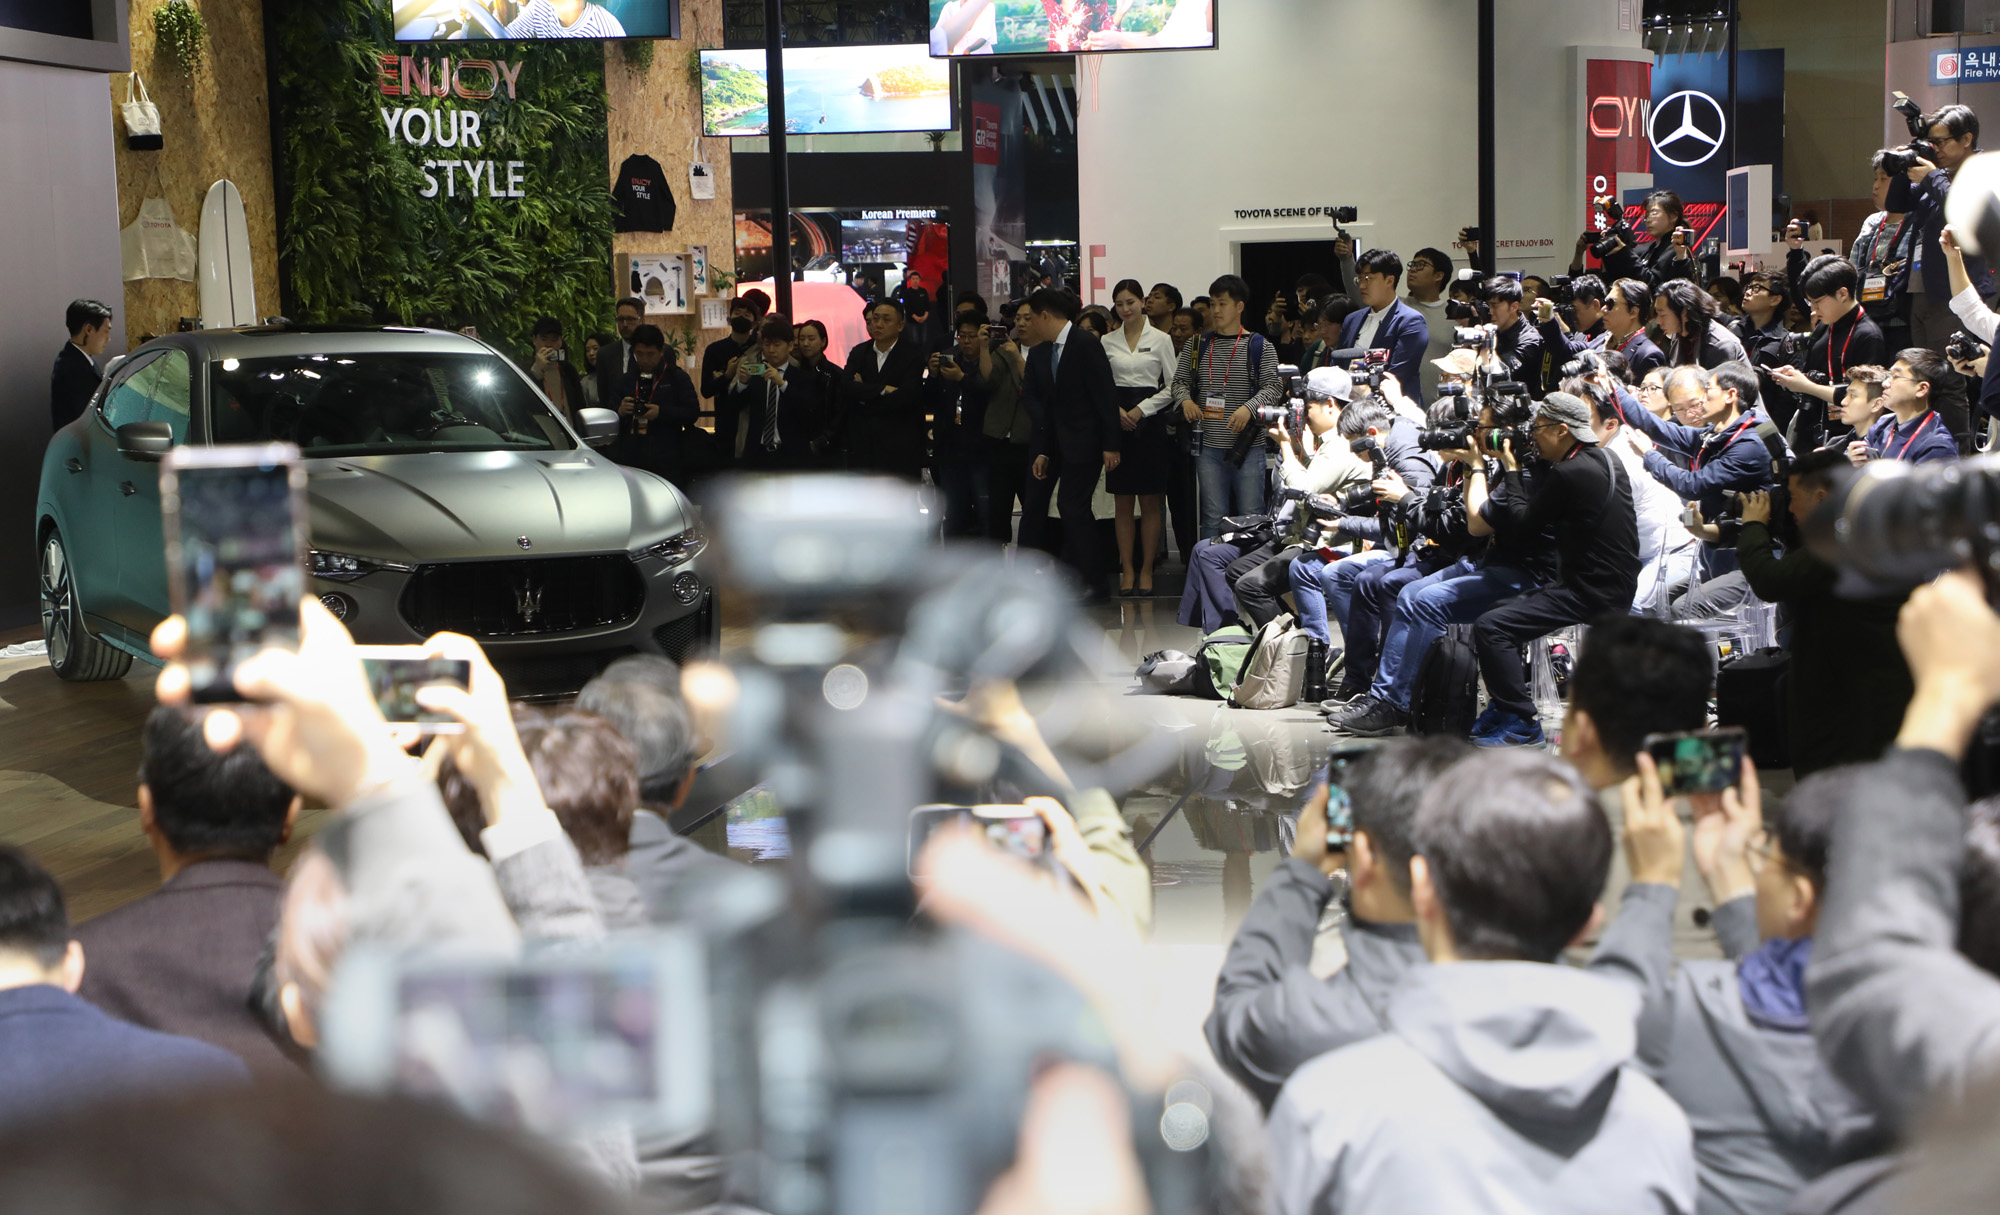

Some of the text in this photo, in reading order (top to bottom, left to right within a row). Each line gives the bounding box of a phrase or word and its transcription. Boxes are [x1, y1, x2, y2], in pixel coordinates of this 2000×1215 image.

[1965, 51, 2000, 68] 옥내
[378, 55, 523, 100] ENJOY
[1965, 69, 1983, 78] Fire
[1586, 96, 1638, 138] OY
[381, 107, 482, 148] YOUR
[976, 129, 986, 147] GR
[420, 159, 526, 198] STYLE
[631, 178, 651, 186] ENJOY
[636, 192, 650, 200] STYLE
[861, 209, 937, 220] Korean Premiere
[1234, 208, 1272, 218] TOYOTA
[1273, 208, 1306, 217] SCENE
[1308, 207, 1322, 216] OF
[1516, 239, 1539, 248] ENJOY
[1540, 238, 1554, 247] BOX
